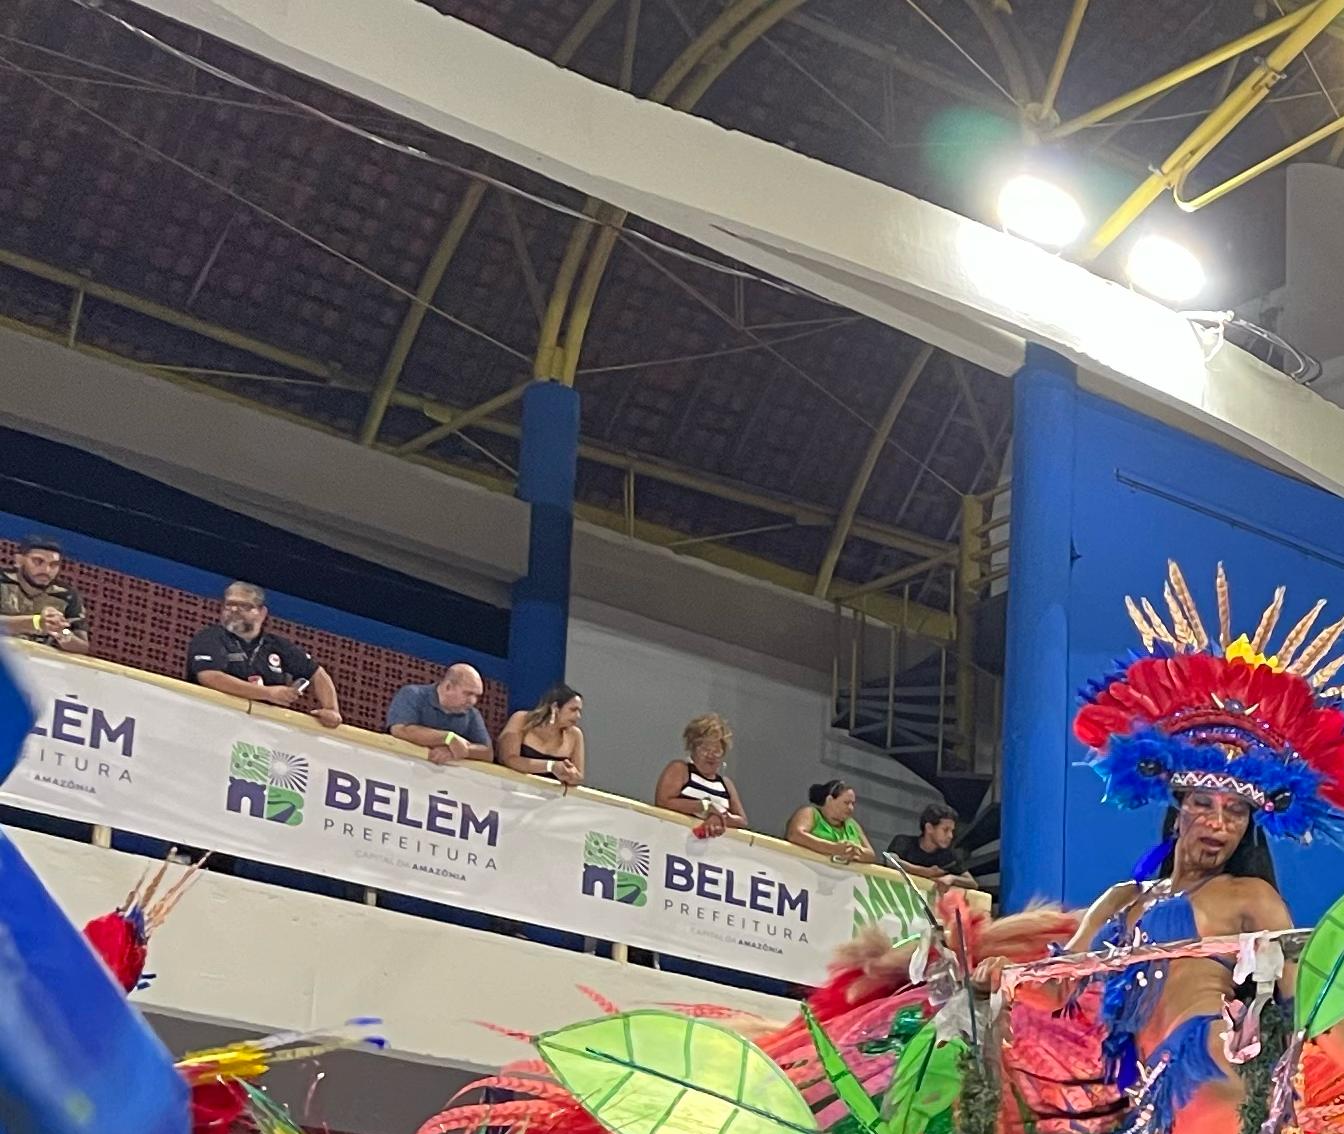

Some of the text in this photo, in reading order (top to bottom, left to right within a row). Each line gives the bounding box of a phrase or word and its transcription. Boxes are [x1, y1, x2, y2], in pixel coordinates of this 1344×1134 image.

[40, 748, 132, 784] ITURA
[325, 768, 499, 847] BELÉM
[324, 818, 497, 870] PREFEITURA
[412, 863, 467, 881] AMAZÔNIA
[664, 853, 809, 922] BELÉM
[664, 899, 808, 944] PREFEITURA
